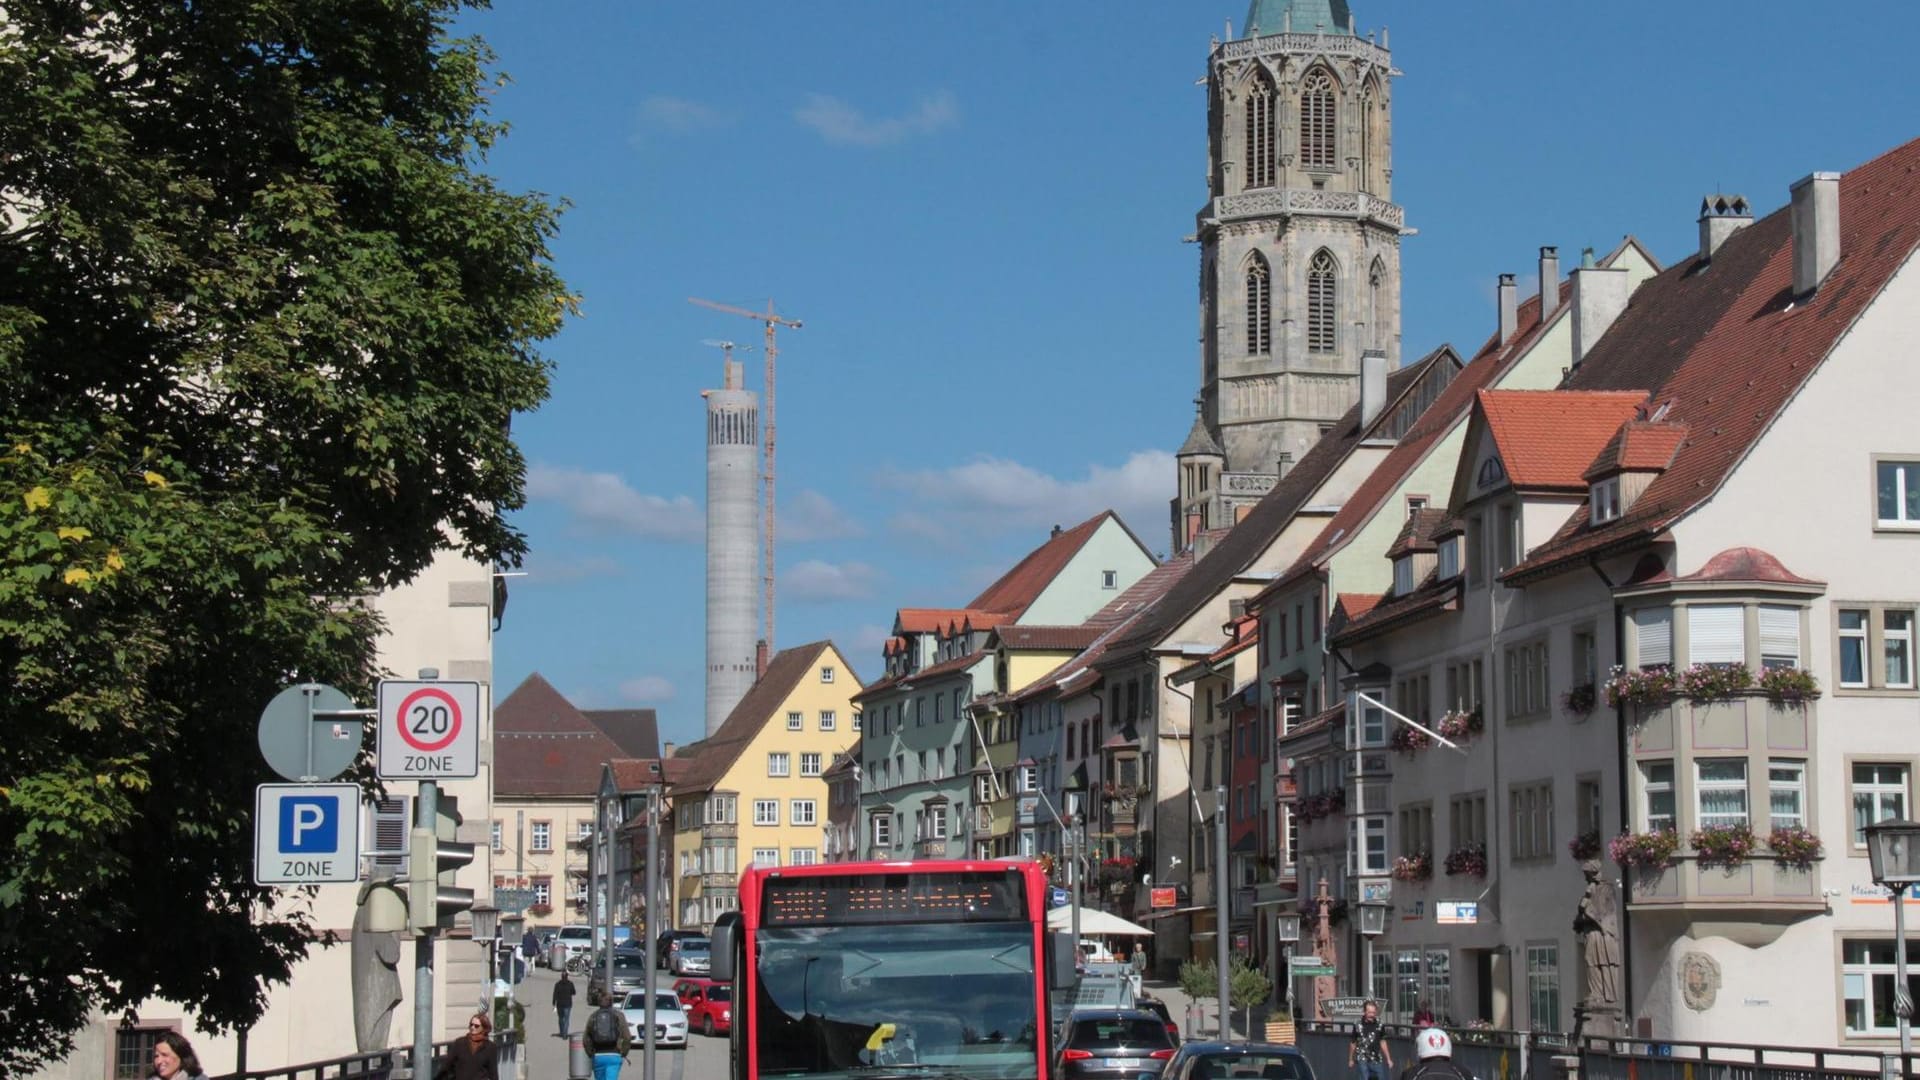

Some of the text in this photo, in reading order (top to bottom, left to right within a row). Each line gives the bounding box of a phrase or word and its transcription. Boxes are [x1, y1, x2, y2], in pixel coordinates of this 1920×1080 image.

[412, 705, 448, 734] 20
[404, 755, 453, 771] ZONE
[293, 803, 325, 846] P
[283, 860, 332, 877] ZONE
